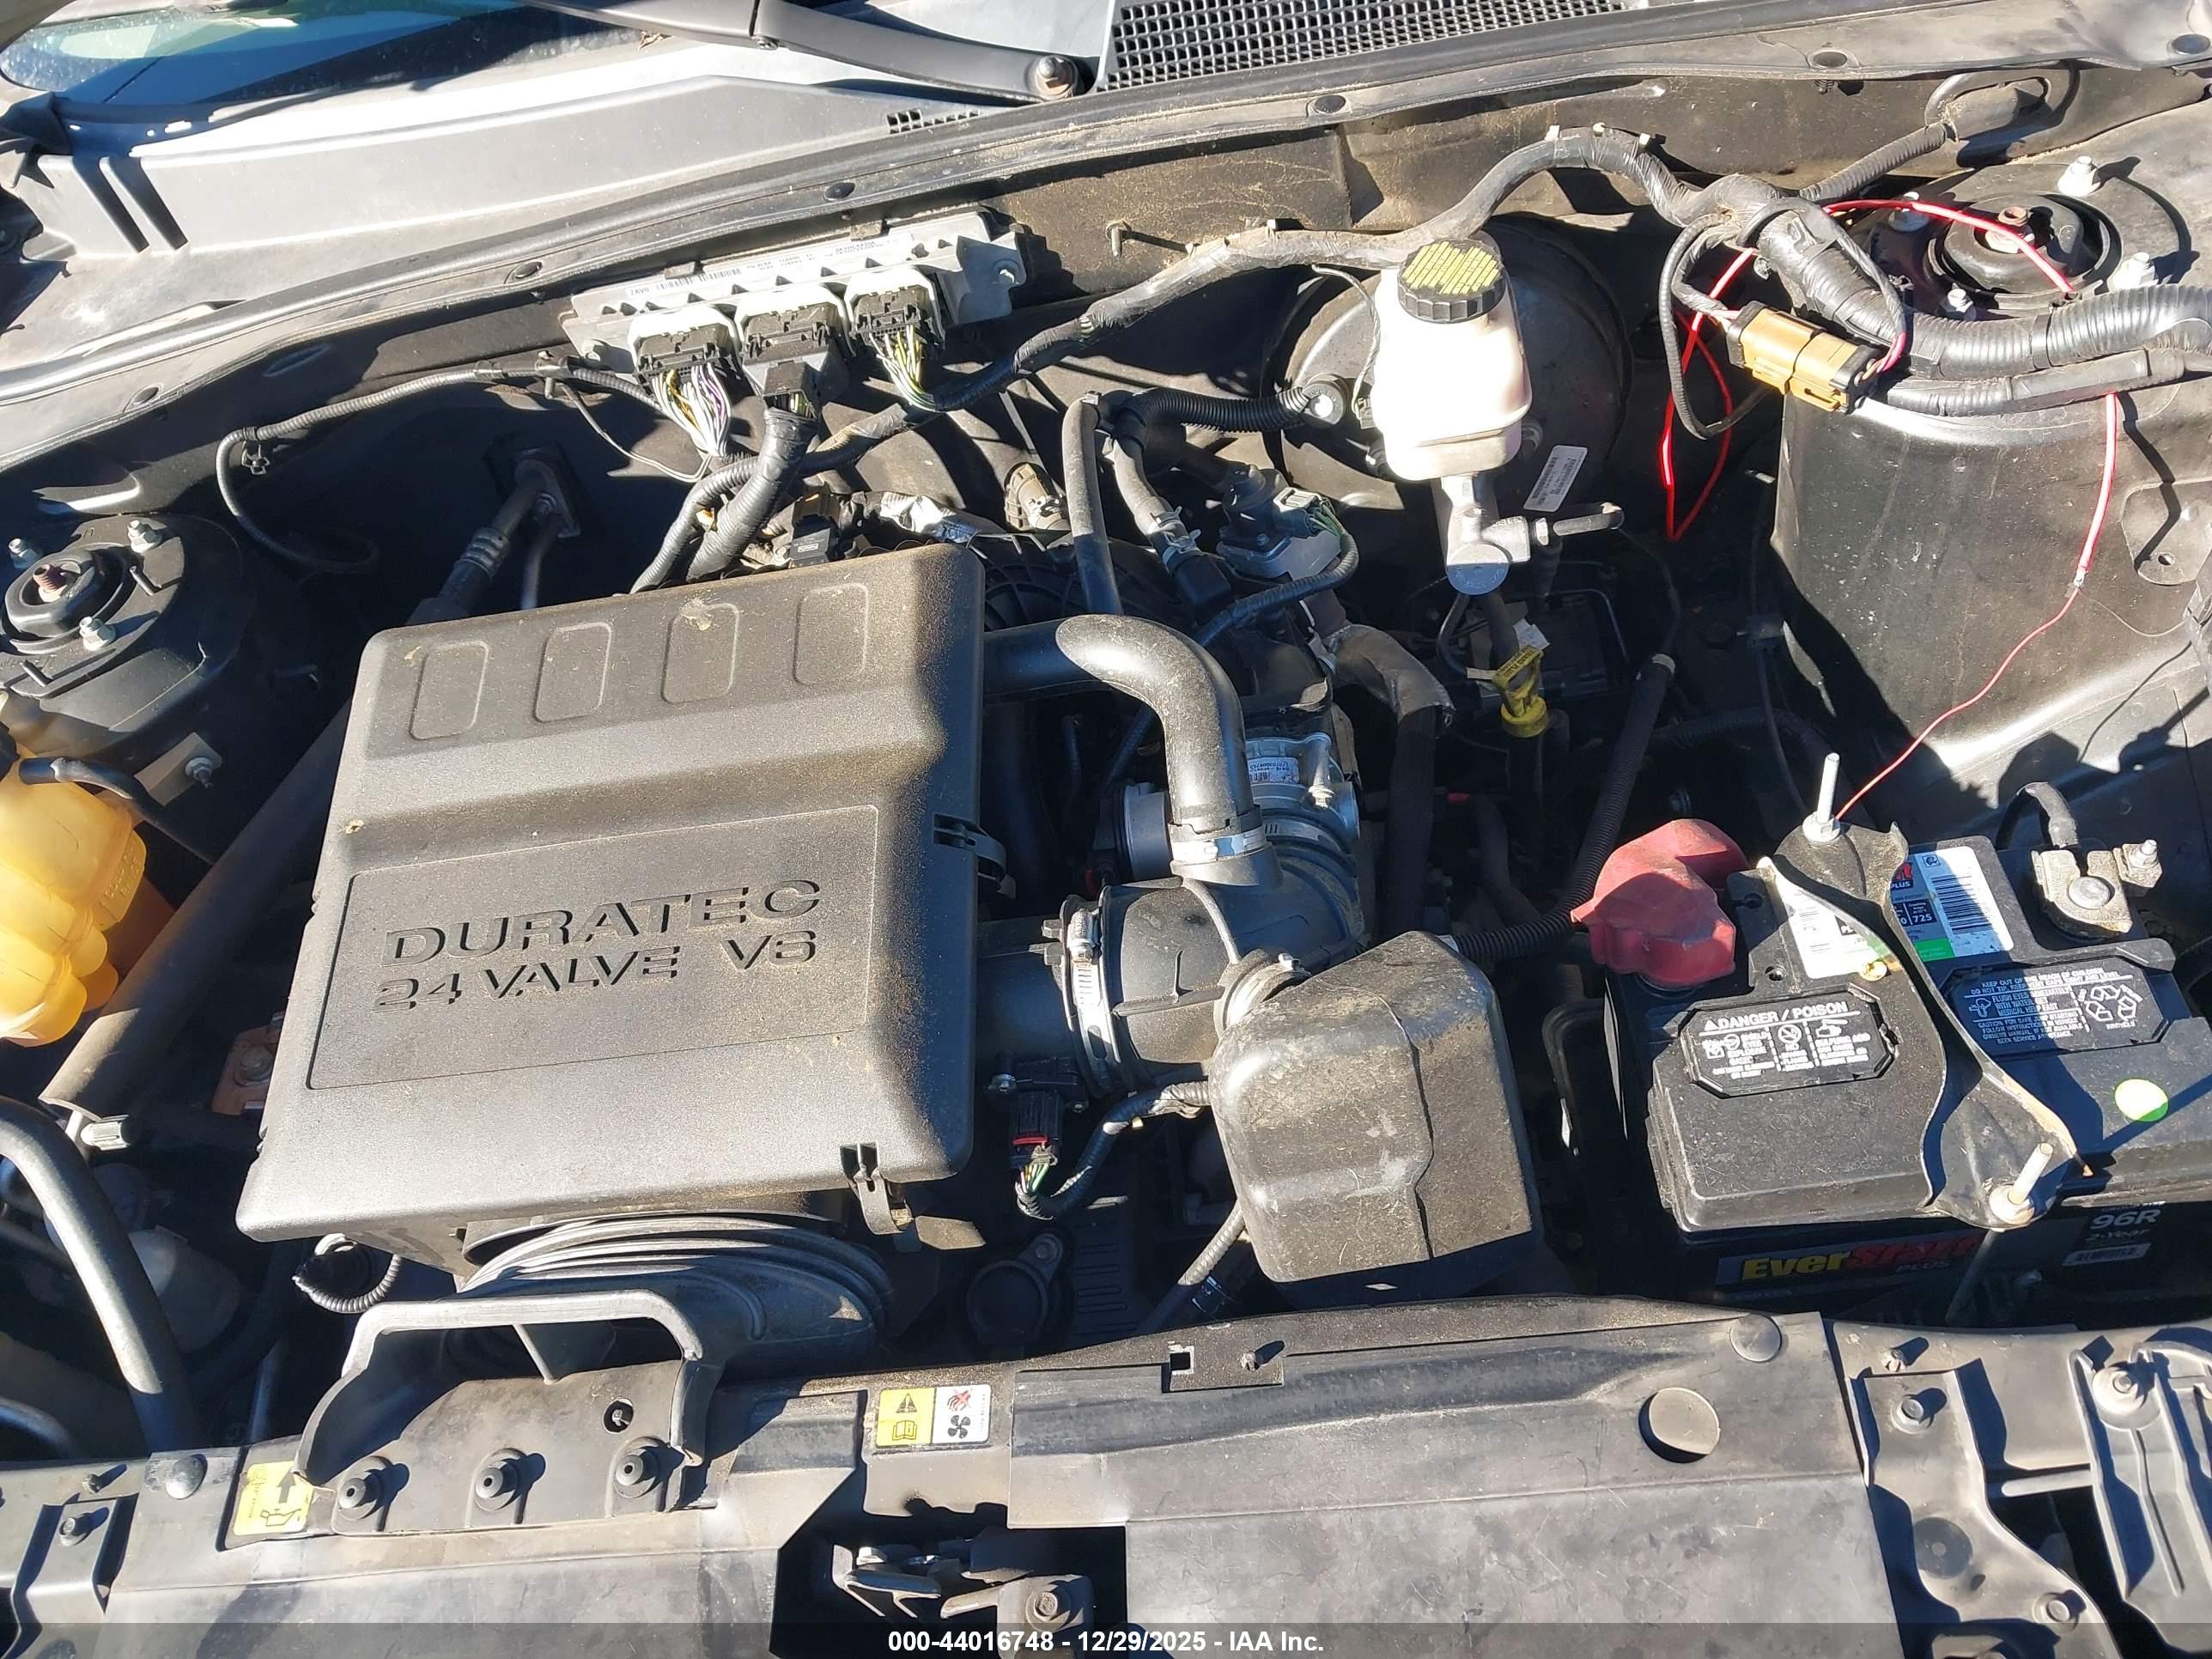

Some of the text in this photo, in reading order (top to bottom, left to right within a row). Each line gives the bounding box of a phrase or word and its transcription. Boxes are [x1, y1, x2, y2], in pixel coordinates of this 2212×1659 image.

[380, 879, 821, 967] DURATEC
[1911, 914, 1932, 923] 725
[373, 930, 817, 1013] 24 VALVE V6
[1992, 994, 2013, 1003] FLUSH
[2014, 992, 2029, 1000] EYES
[1995, 1001, 2012, 1010] WITH
[1997, 1007, 2026, 1016] MEDICAL
[2026, 1004, 2042, 1012] HELP
[1717, 1011, 1779, 1030] DANGER
[1792, 1001, 1849, 1019] POISON
[2091, 1209, 2161, 1230] 96R
[1895, 1262, 1951, 1274] PLUS
